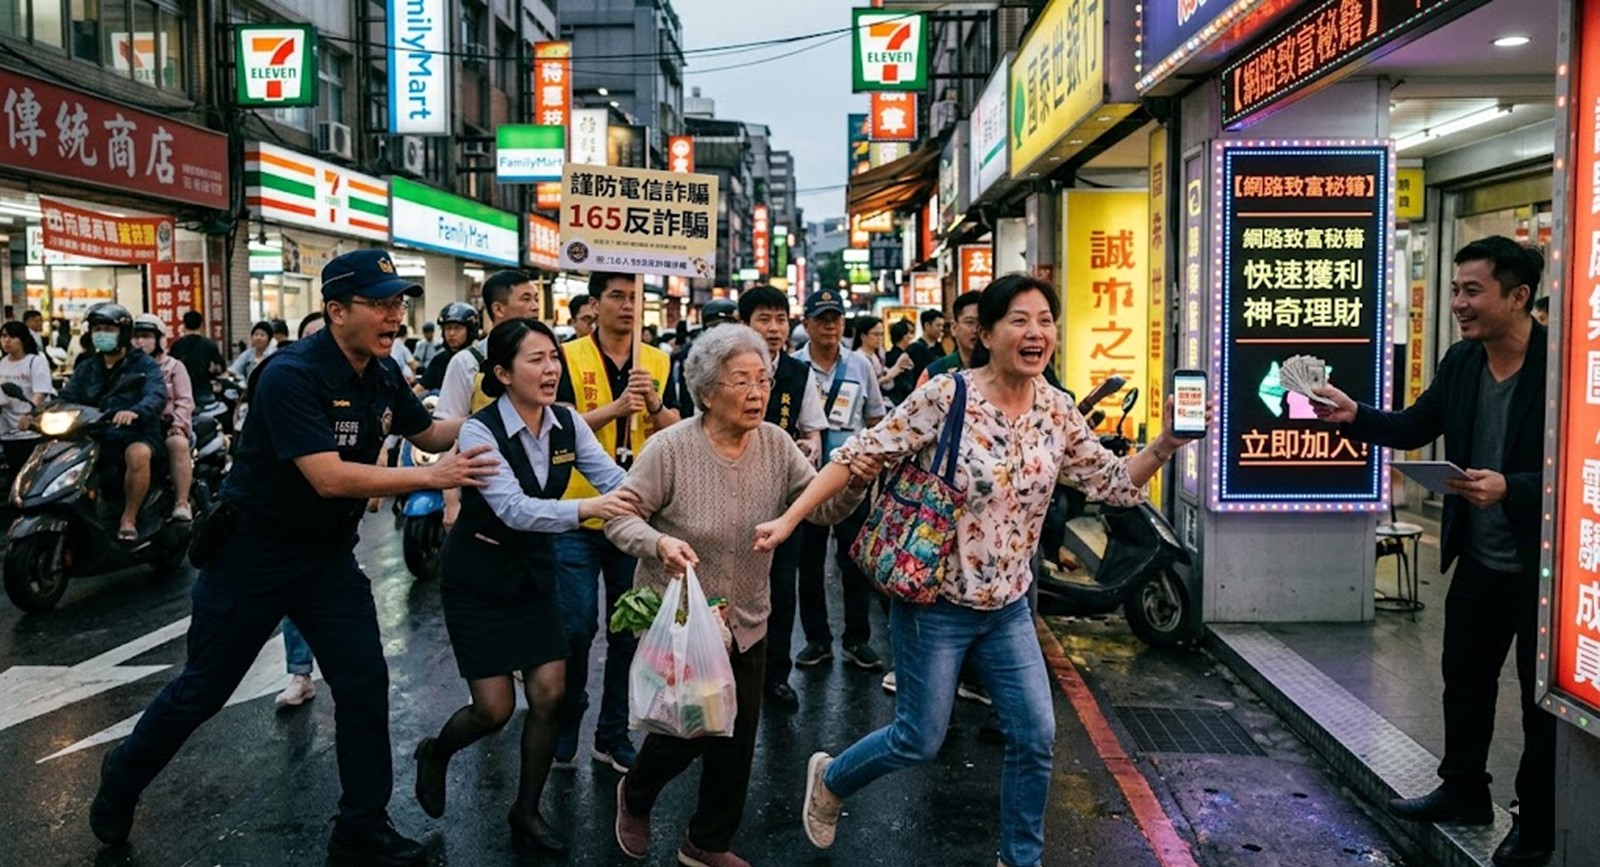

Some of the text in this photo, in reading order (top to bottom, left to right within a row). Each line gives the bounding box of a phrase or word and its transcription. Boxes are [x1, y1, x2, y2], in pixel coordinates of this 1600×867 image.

[4, 87, 176, 184] 傳統商店
[499, 156, 562, 169] FamilyMart
[570, 172, 710, 206] 謹防電信詐騙
[568, 203, 709, 240] 165反詐騙
[1242, 258, 1364, 291] 快速獲利
[1242, 296, 1364, 328] 神奇理財
